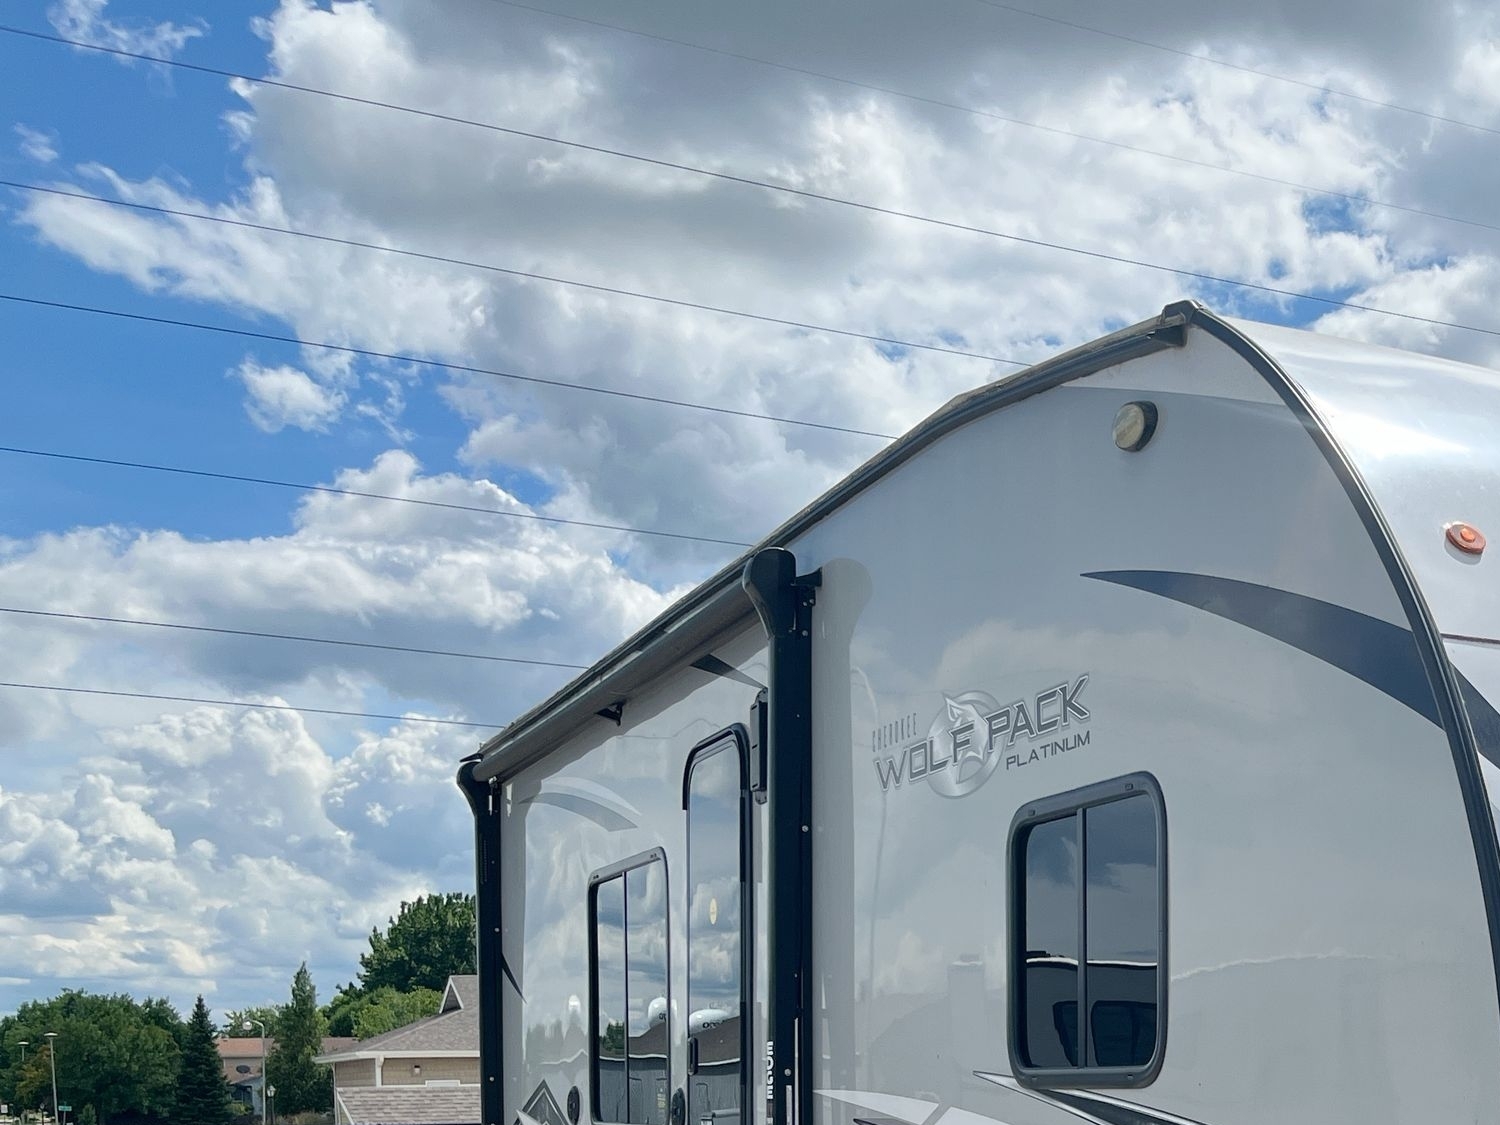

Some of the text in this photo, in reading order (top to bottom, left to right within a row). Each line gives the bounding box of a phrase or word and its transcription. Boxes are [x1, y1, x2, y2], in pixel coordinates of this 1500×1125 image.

[873, 673, 1091, 791] WOLF PACK
[1006, 730, 1091, 770] PLATINUM
